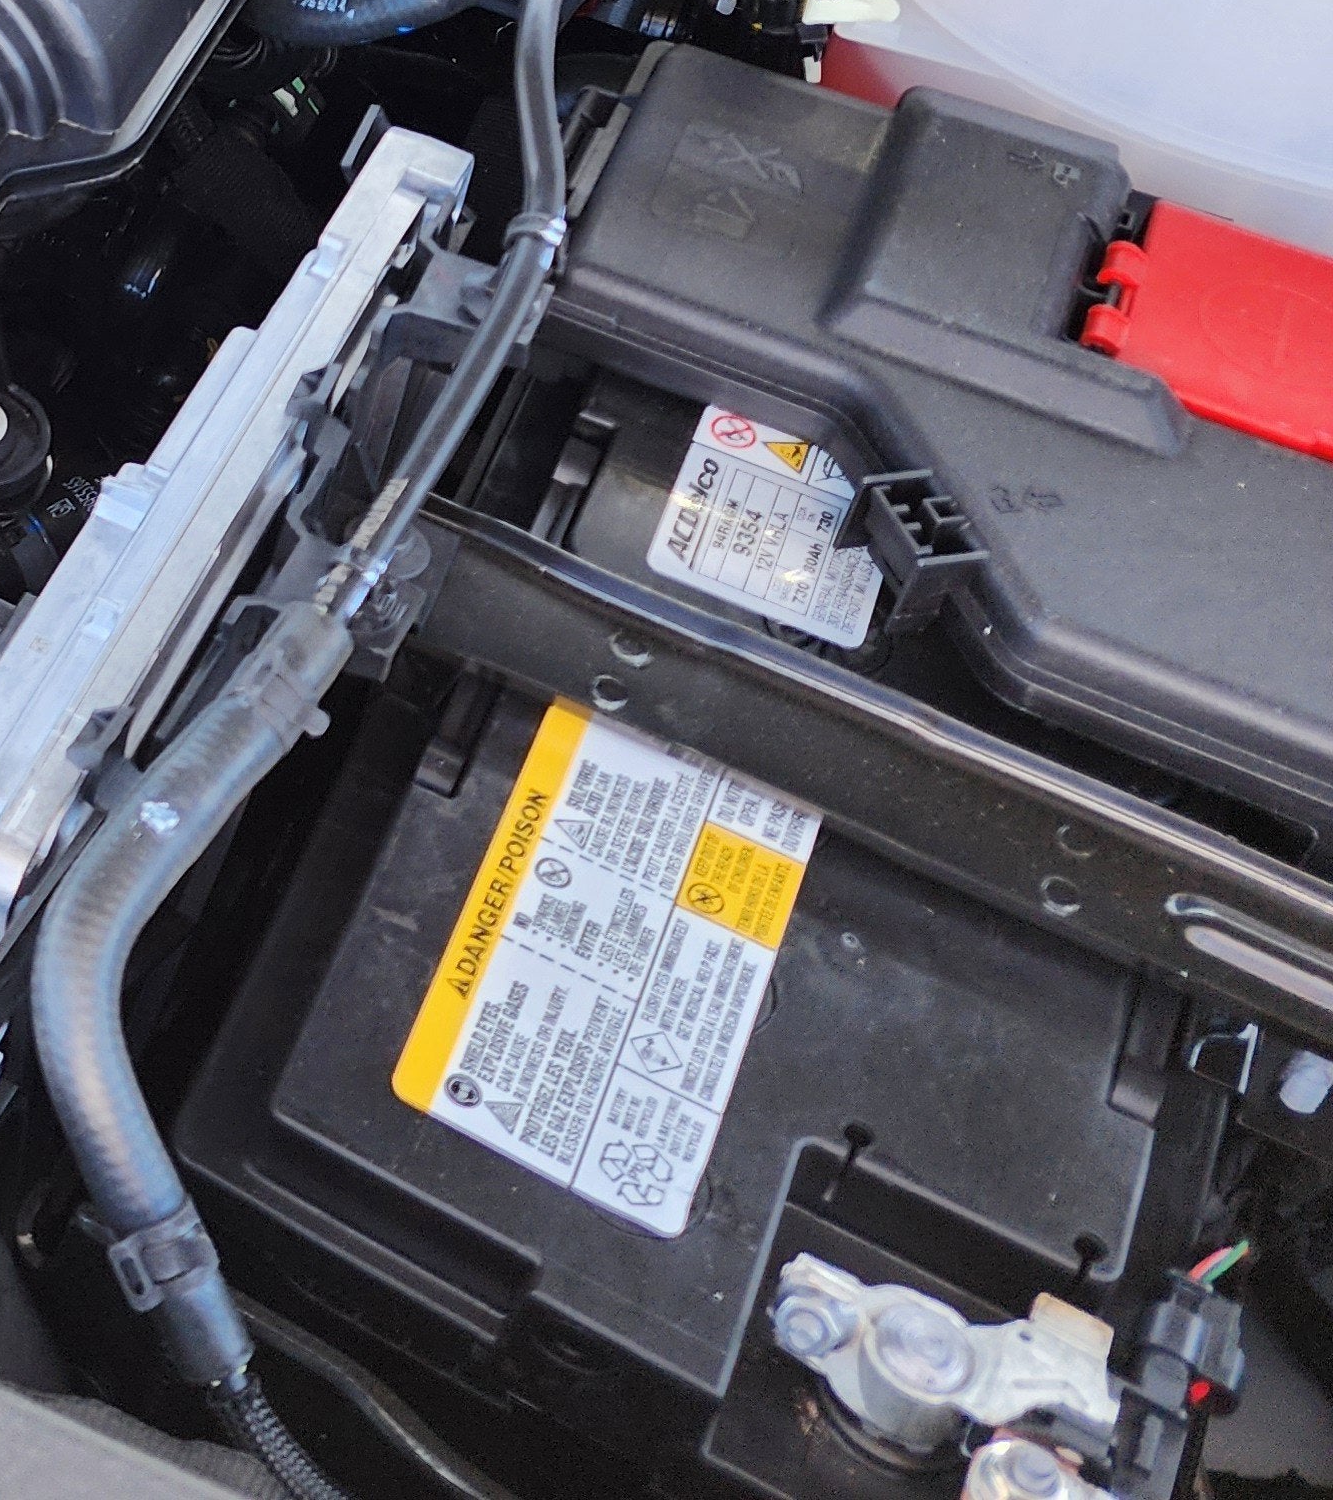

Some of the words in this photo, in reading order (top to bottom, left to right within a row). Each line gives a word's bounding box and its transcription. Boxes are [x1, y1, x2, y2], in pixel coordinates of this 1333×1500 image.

[666, 454, 721, 561] ACDelco
[729, 506, 765, 558] 9354
[814, 508, 835, 535] 730
[564, 757, 599, 811] SULFURIC
[453, 784, 550, 979] DANGER/POISON
[475, 1016, 515, 1085] EXPLOSIVE
[500, 978, 529, 1021] GASES
